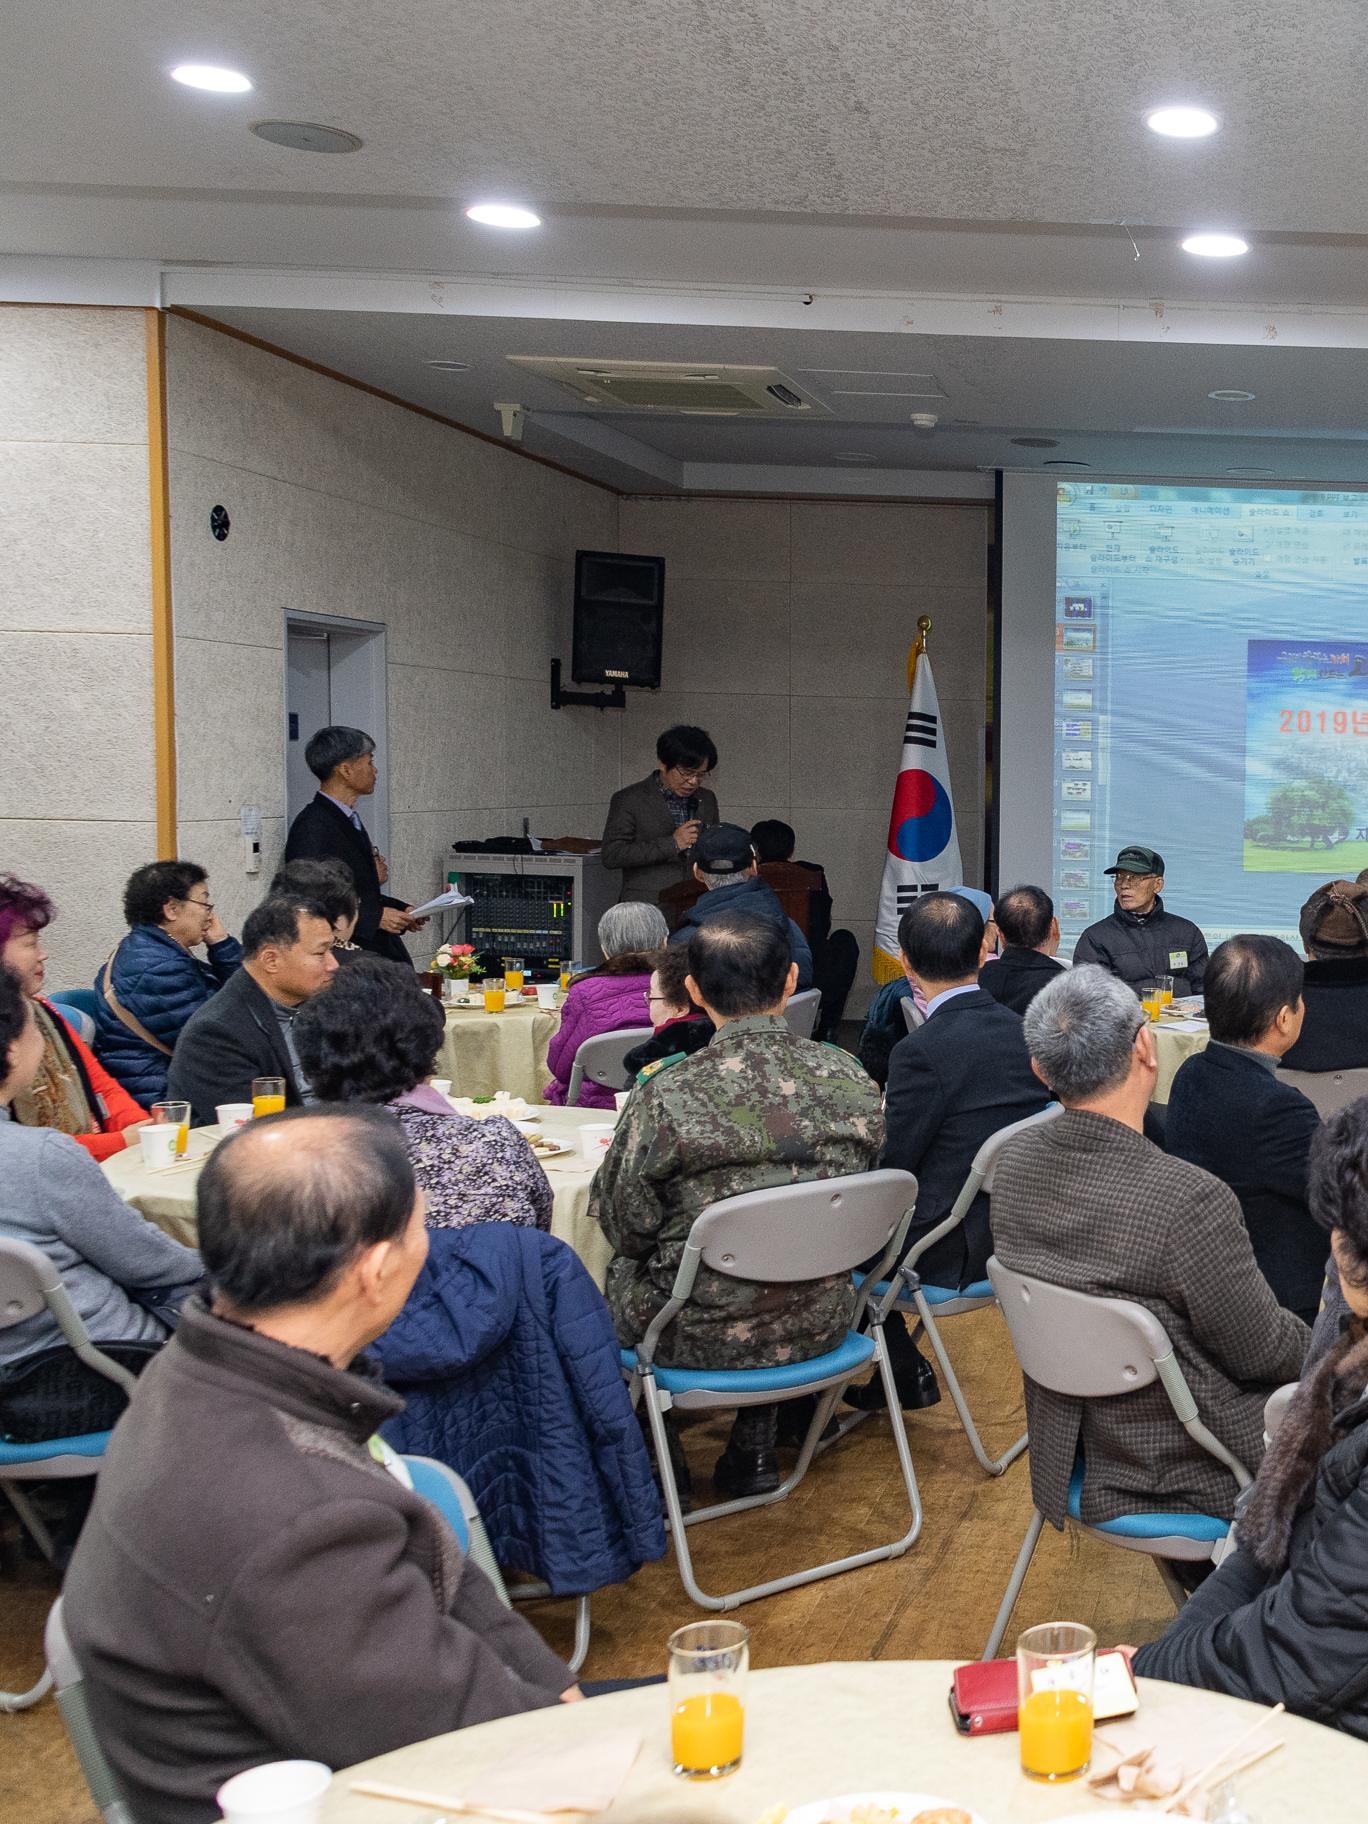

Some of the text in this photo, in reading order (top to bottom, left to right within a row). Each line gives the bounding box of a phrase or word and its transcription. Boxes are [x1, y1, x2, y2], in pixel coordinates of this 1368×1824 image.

[1150, 505, 1173, 514] 디자인
[1191, 506, 1230, 515] 애니메이션
[1249, 508, 1280, 517] 슬라이드
[1343, 510, 1358, 519] 보기
[1149, 545, 1180, 554] 슬라이드
[1229, 547, 1260, 556] 슬라이드
[1090, 554, 1136, 563] 슬라이드부터
[1232, 558, 1256, 566] 숨기기
[1090, 566, 1122, 575] 슬라이드
[605, 669, 629, 679] YAMAHA
